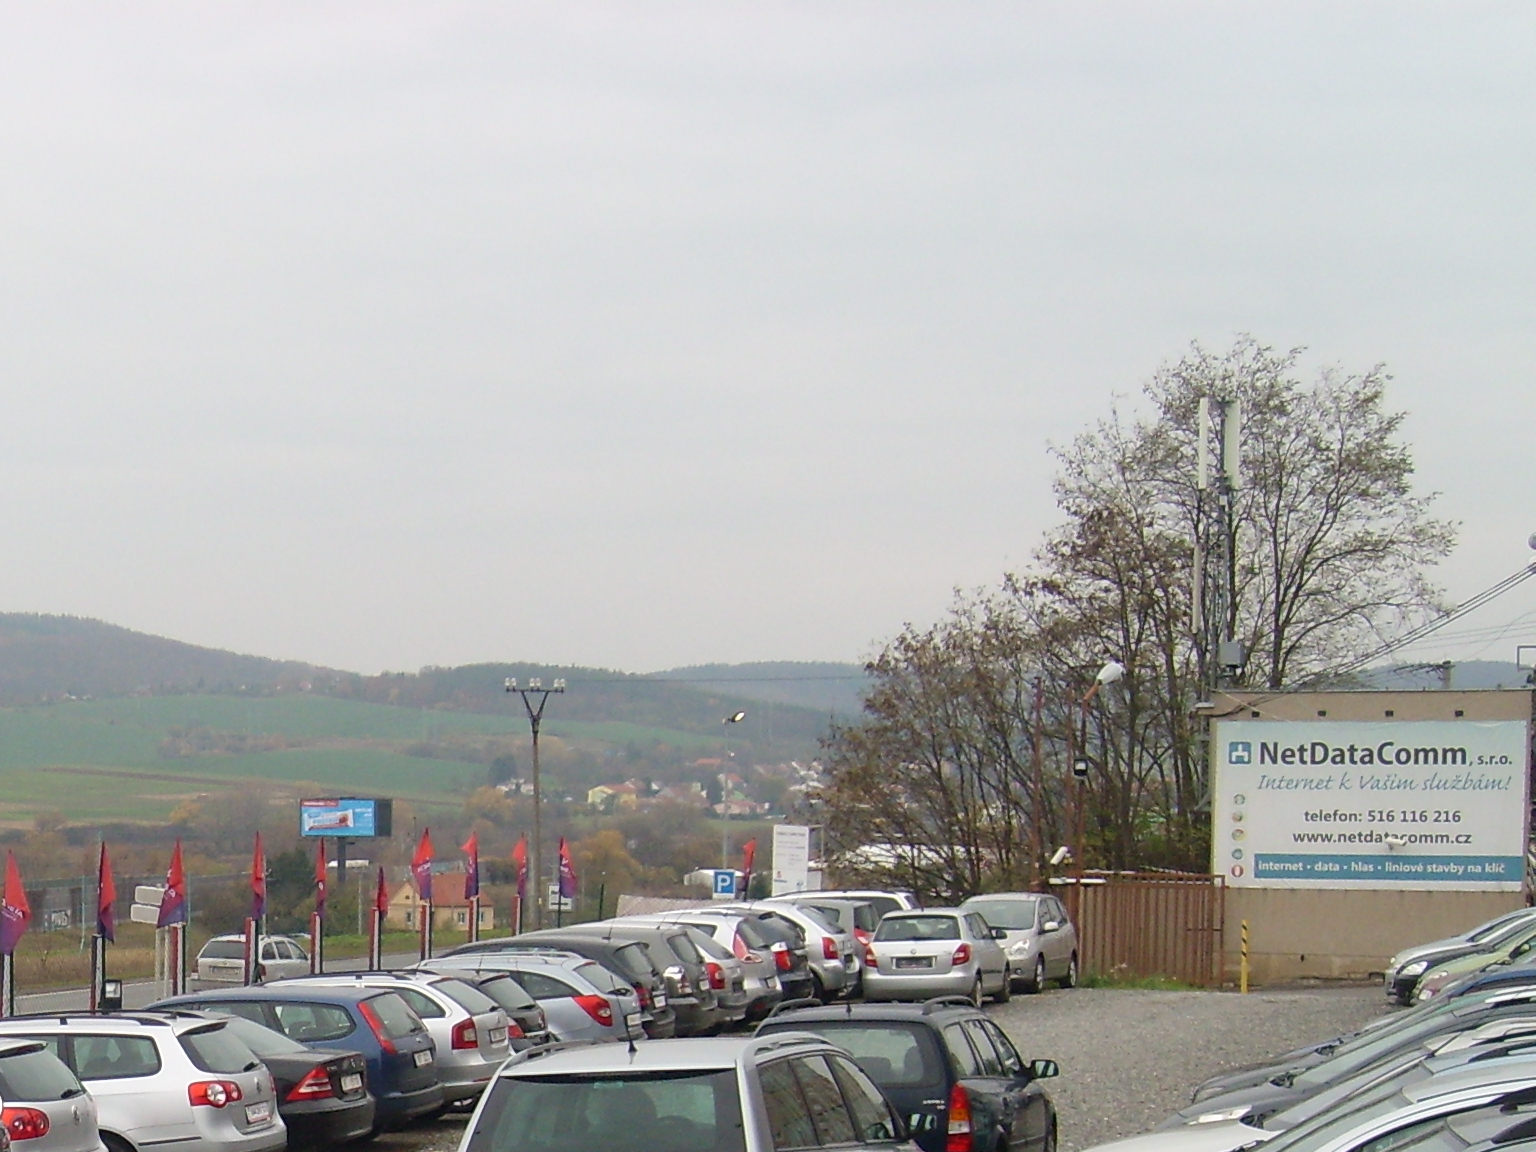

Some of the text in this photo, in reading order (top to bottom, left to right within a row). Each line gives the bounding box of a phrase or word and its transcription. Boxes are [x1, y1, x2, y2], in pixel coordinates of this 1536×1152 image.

[1477, 754, 1513, 765] s.r.o.
[1257, 774, 1335, 790] Internet
[1339, 772, 1353, 790] k
[1421, 772, 1512, 791] službám!
[1304, 809, 1461, 823] telefon: 516 116 216
[1258, 860, 1303, 871] internet
[1314, 861, 1340, 871] data
[1351, 861, 1374, 872] hlas
[1385, 862, 1423, 872] liniové
[1427, 862, 1464, 875] stavby
[1467, 865, 1482, 873] na
[717, 875, 731, 892] P
